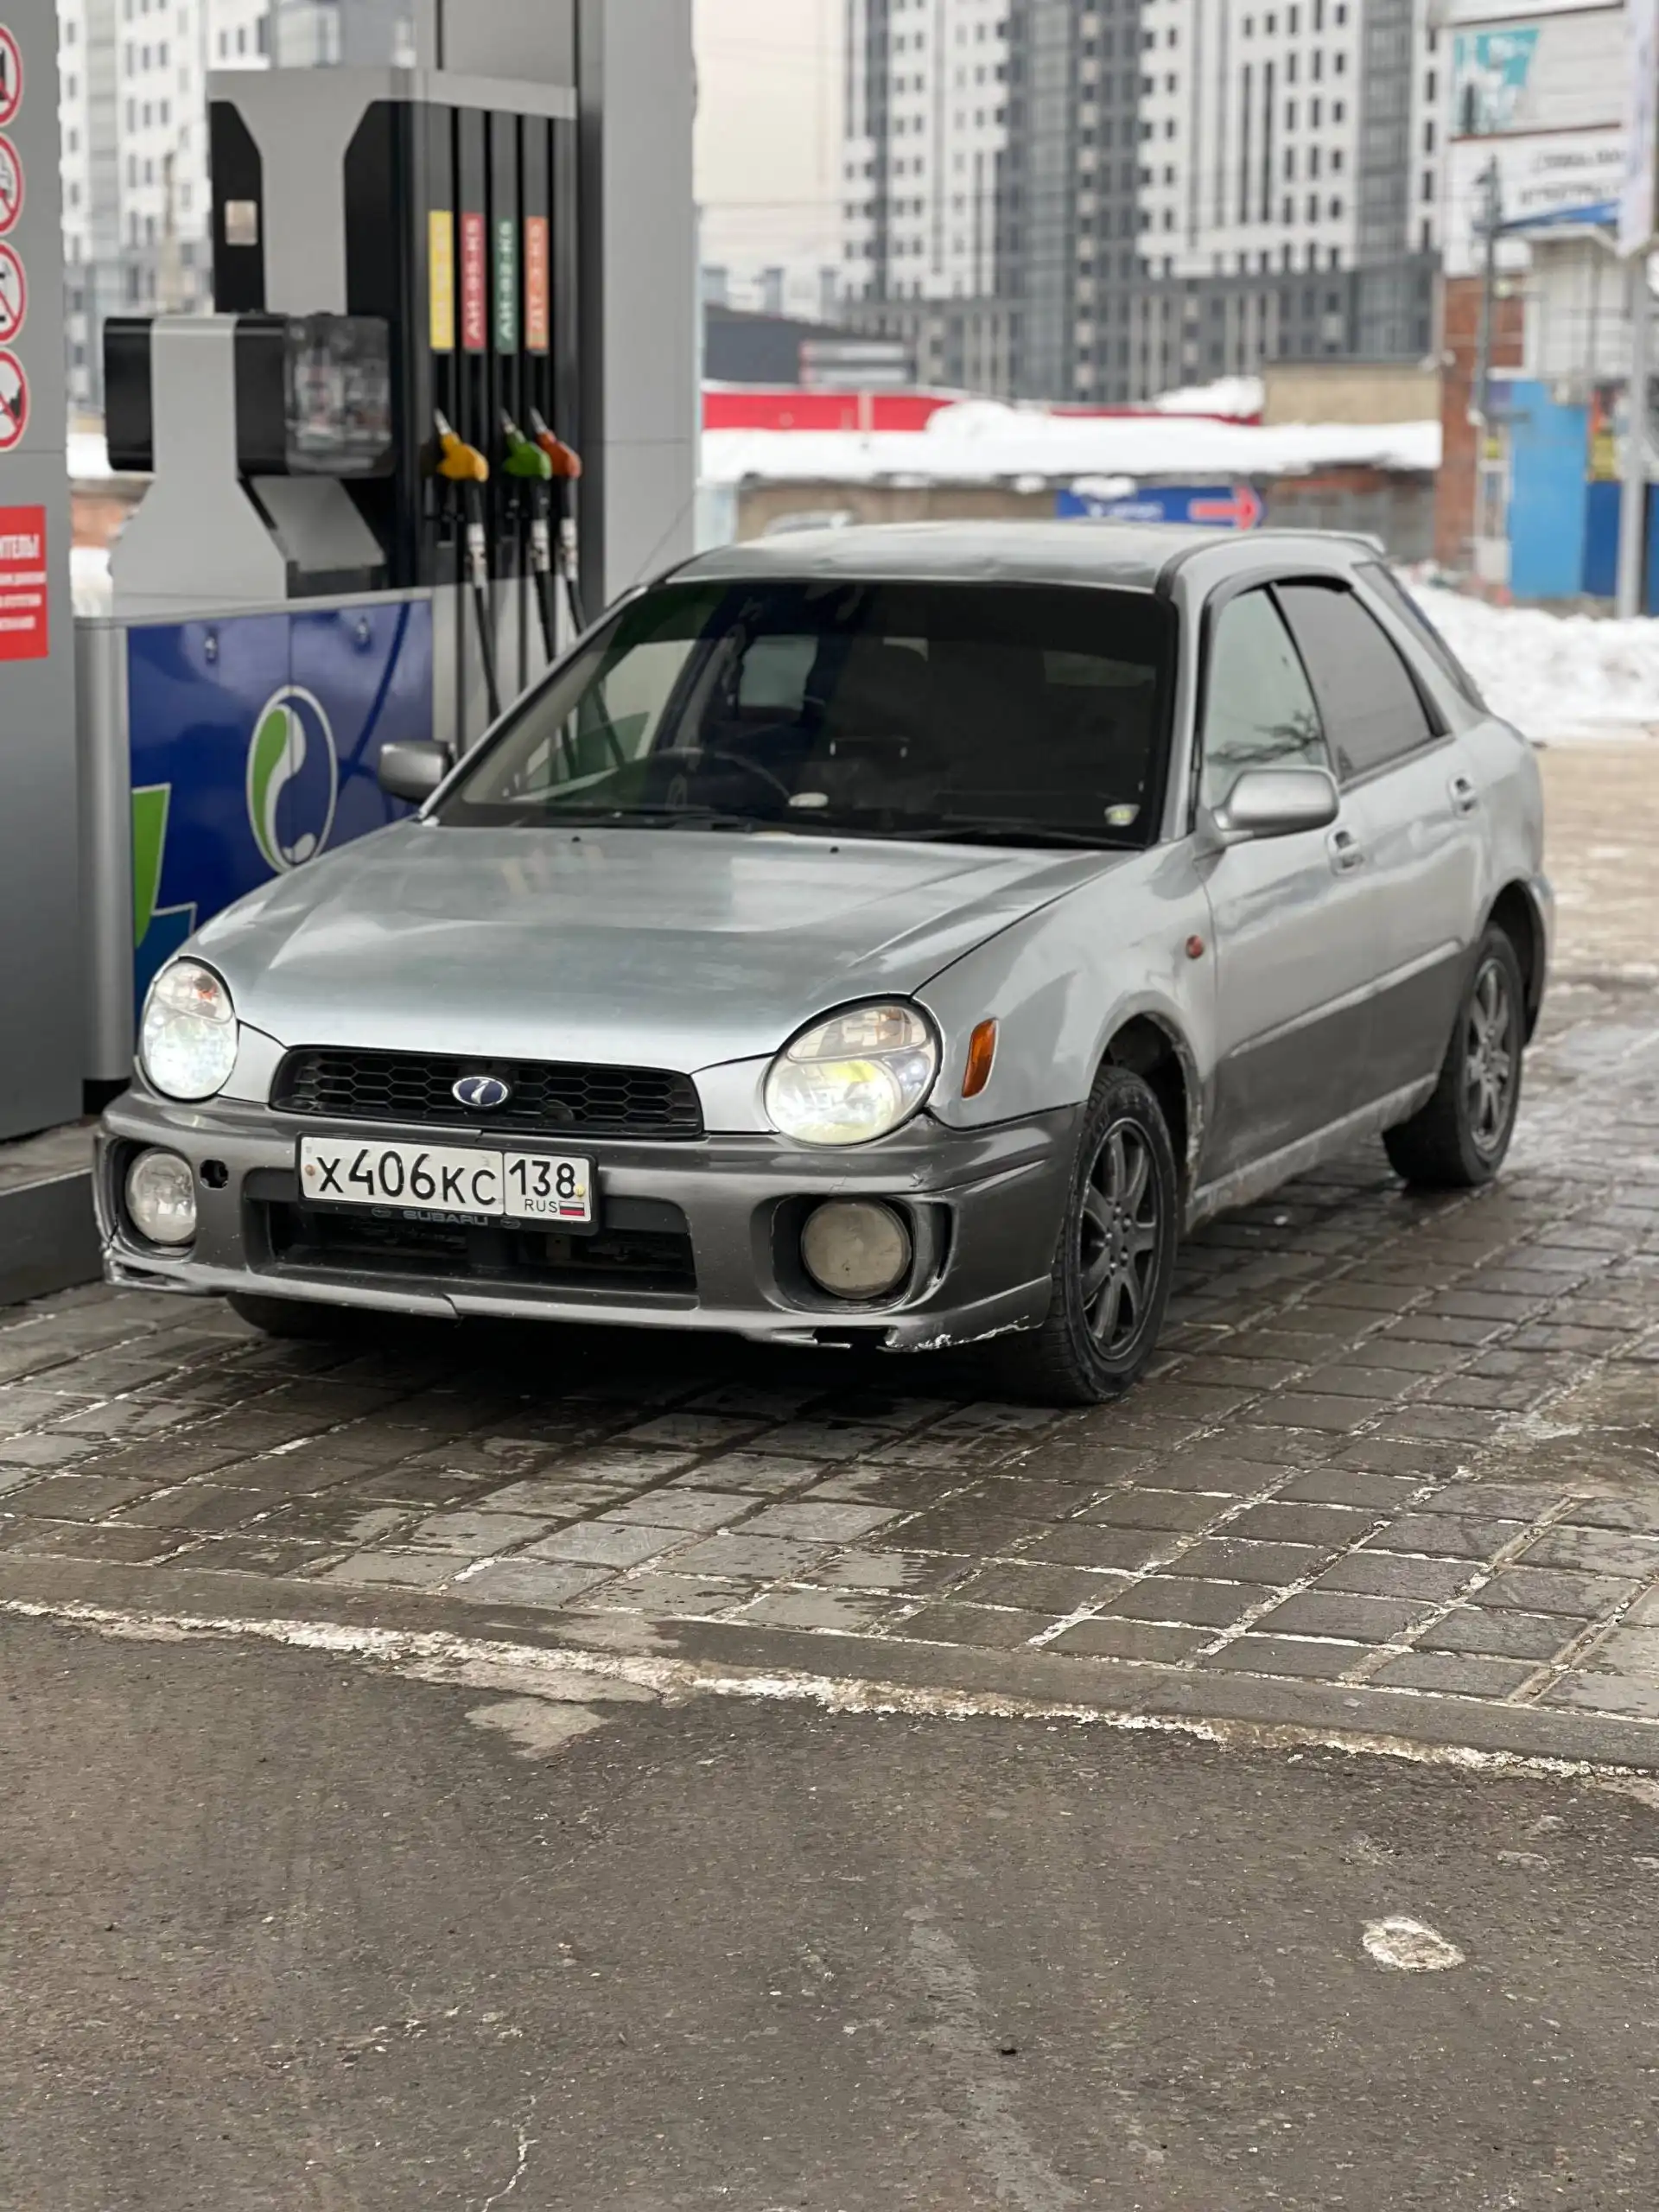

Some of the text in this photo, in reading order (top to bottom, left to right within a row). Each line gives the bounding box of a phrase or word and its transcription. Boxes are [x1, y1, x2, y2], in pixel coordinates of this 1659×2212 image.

[508, 1159, 575, 1199] 138
[524, 1198, 558, 1214] RUS
[403, 1210, 489, 1226] SUBARU
